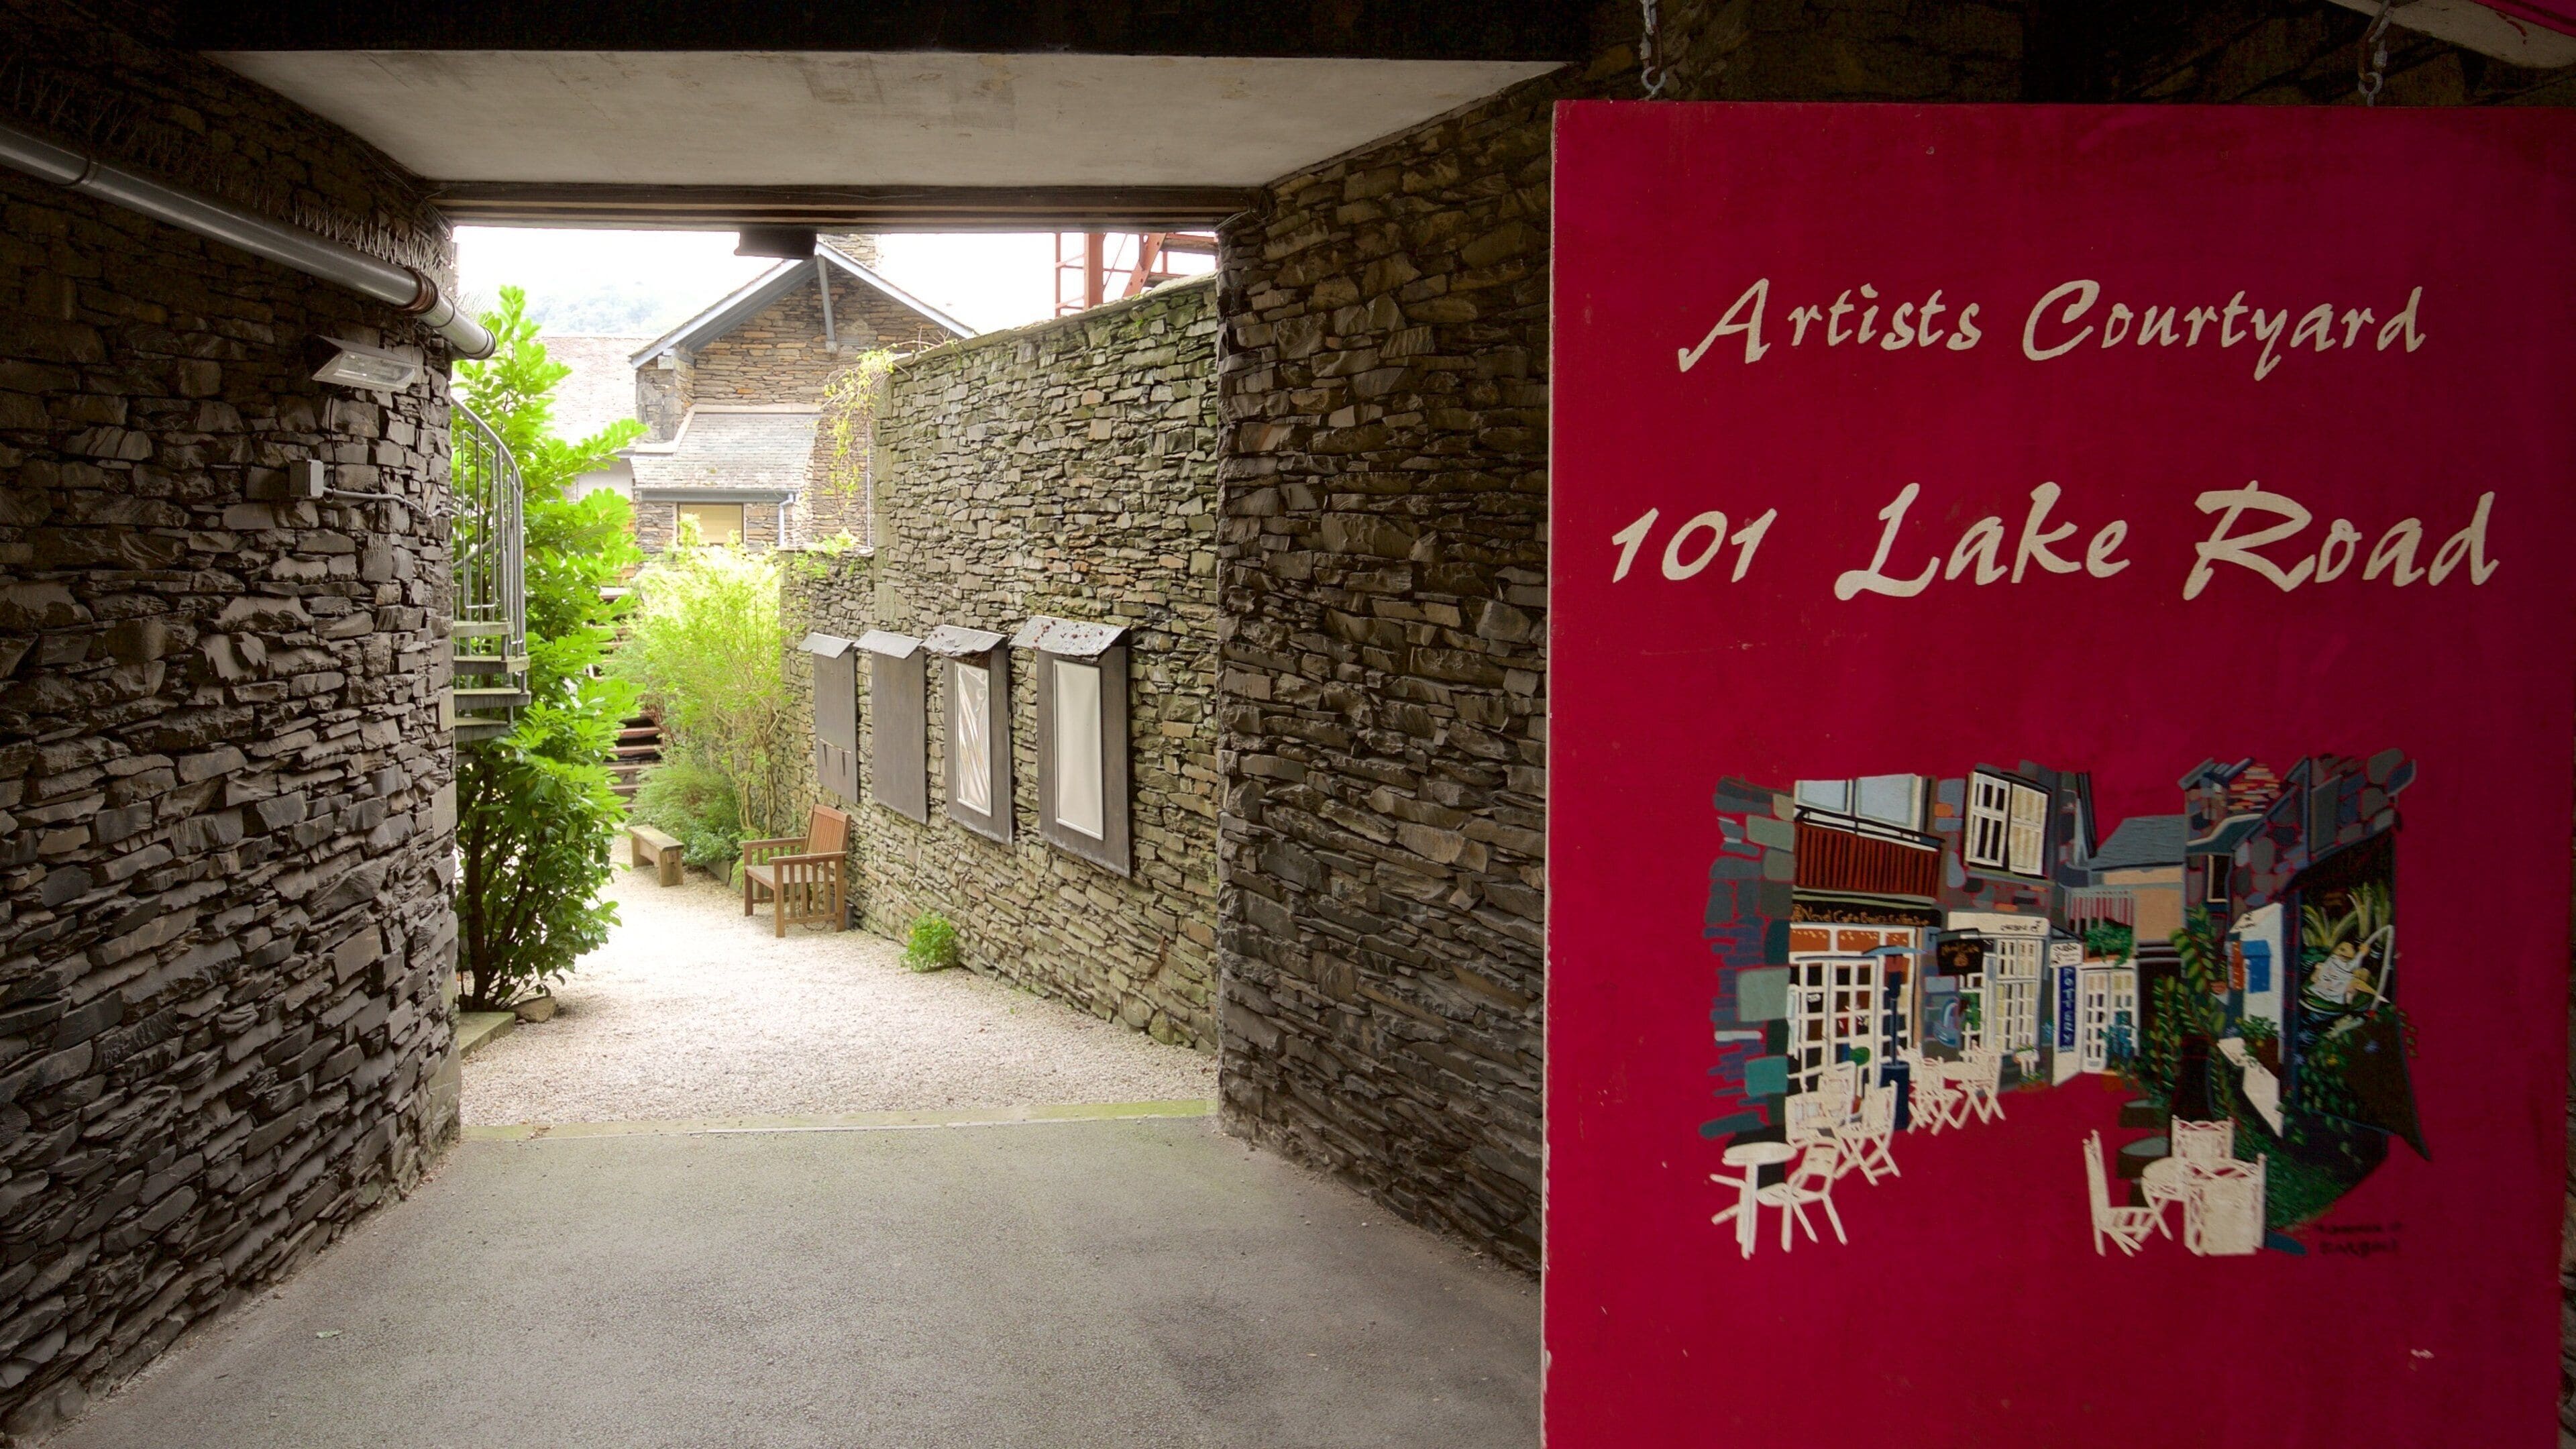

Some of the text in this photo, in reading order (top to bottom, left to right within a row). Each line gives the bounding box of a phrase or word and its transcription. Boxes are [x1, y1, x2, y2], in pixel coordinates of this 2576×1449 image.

[1677, 278, 2426, 382] Artists Courtyard
[1611, 480, 2500, 601] 101 Lake Road
